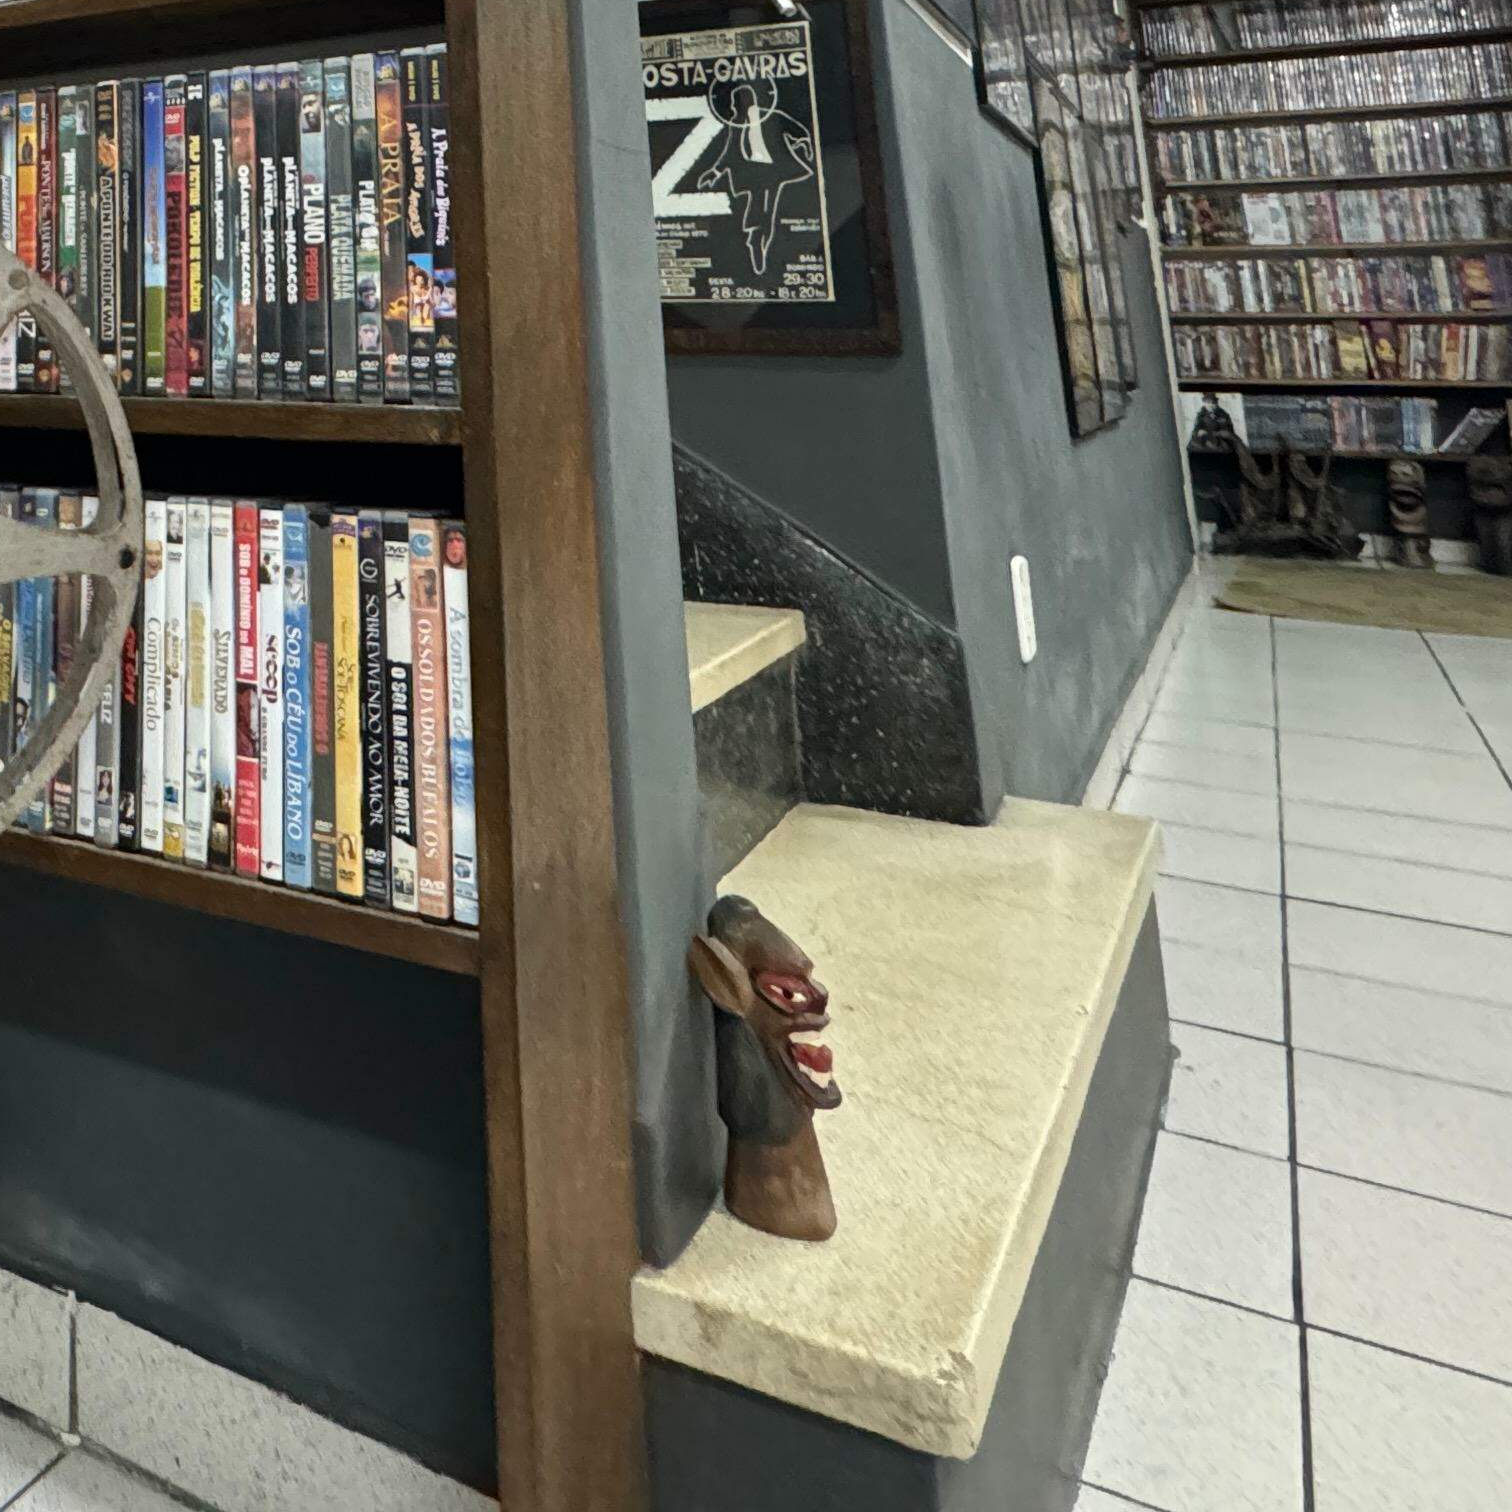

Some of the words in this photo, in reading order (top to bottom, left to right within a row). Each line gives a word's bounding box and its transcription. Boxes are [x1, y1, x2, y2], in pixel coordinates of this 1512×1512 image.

[643, 51, 808, 88] OSTA-GAVRAS
[189, 135, 201, 161] PULP
[381, 113, 397, 131] A
[431, 128, 446, 139] A
[211, 138, 225, 192] PLANETA
[413, 166, 426, 188] DOS
[433, 141, 448, 178] Praia
[645, 94, 733, 217] Z
[40, 160, 52, 206] PONTES
[237, 176, 251, 228] PLANETA
[261, 157, 277, 217] PLANETA
[282, 157, 299, 217] PLANETA
[383, 142, 402, 226] PRAIA
[100, 188, 115, 240] PONTE
[213, 200, 225, 260] MACACOS
[303, 183, 326, 245] PLANO
[330, 194, 352, 232] PLATA
[40, 220, 53, 273] MADISON
[100, 241, 115, 268] DO
[240, 240, 252, 305] MACACOS
[263, 230, 276, 303] MACACOS
[285, 230, 298, 305] MACACOS
[331, 237, 354, 300] QUEMADA
[100, 268, 115, 296] RIO
[809, 272, 825, 286] 30
[100, 296, 115, 341] KWAI
[238, 543, 252, 568] SOB
[238, 577, 255, 630] DOMÍNIO
[448, 608, 467, 623] A
[213, 628, 231, 714] SILVERADO
[239, 646, 257, 676] MAL
[265, 634, 279, 705] scoop
[286, 626, 303, 667] SOB
[365, 594, 383, 734] SOBREVIVENDO
[450, 630, 470, 711] sombra
[143, 617, 163, 731] Complicado
[390, 667, 405, 679] O
[391, 681, 407, 709] SOL
[286, 688, 308, 729] CÉU
[392, 715, 409, 737] DA
[418, 645, 437, 756] SOLDADOS
[368, 738, 384, 764] AO
[287, 760, 307, 840] LÍBANO
[368, 769, 386, 828] AMOR
[394, 740, 411, 836] MEIA-NOITE
